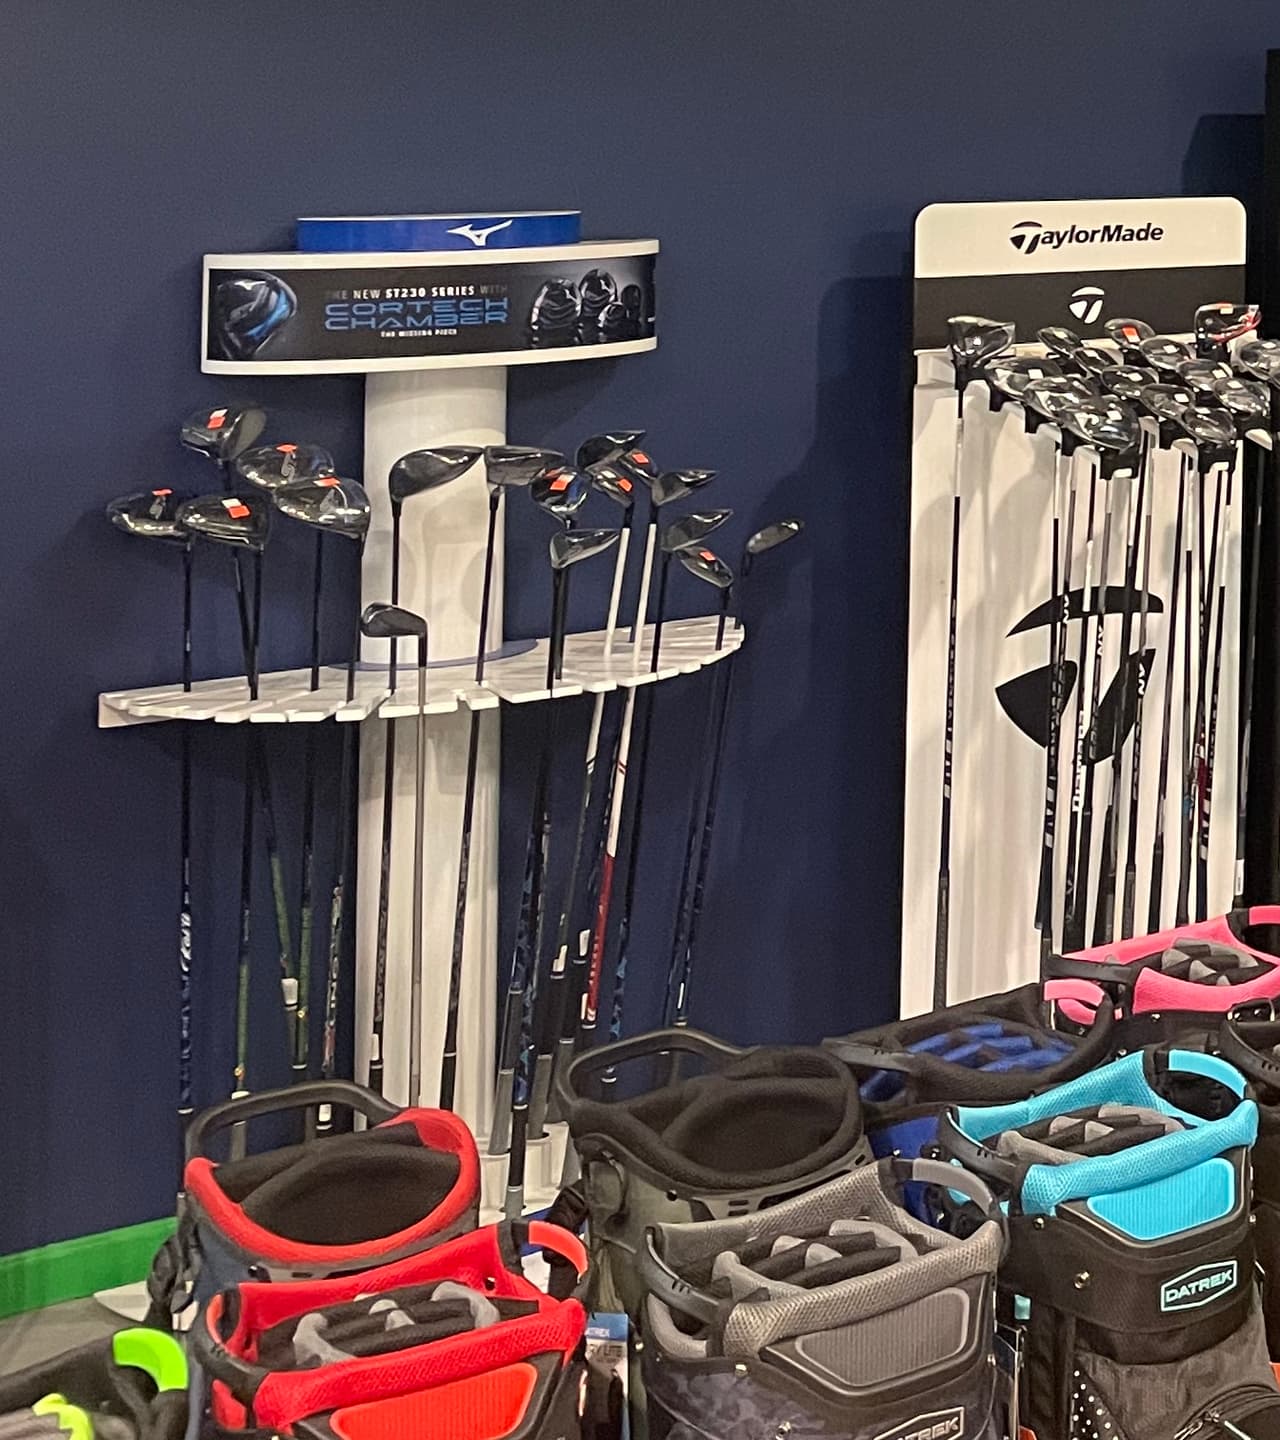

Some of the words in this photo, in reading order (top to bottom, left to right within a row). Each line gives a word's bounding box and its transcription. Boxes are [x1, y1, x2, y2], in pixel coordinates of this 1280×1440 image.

[1009, 221, 1164, 254] TaylorMade
[353, 288, 380, 300] NEW
[385, 287, 426, 299] ST230
[431, 284, 475, 297] SERIES
[324, 297, 508, 316] CORTECH
[324, 311, 508, 330] CHAMBER
[1165, 1269, 1232, 1302] DATREK
